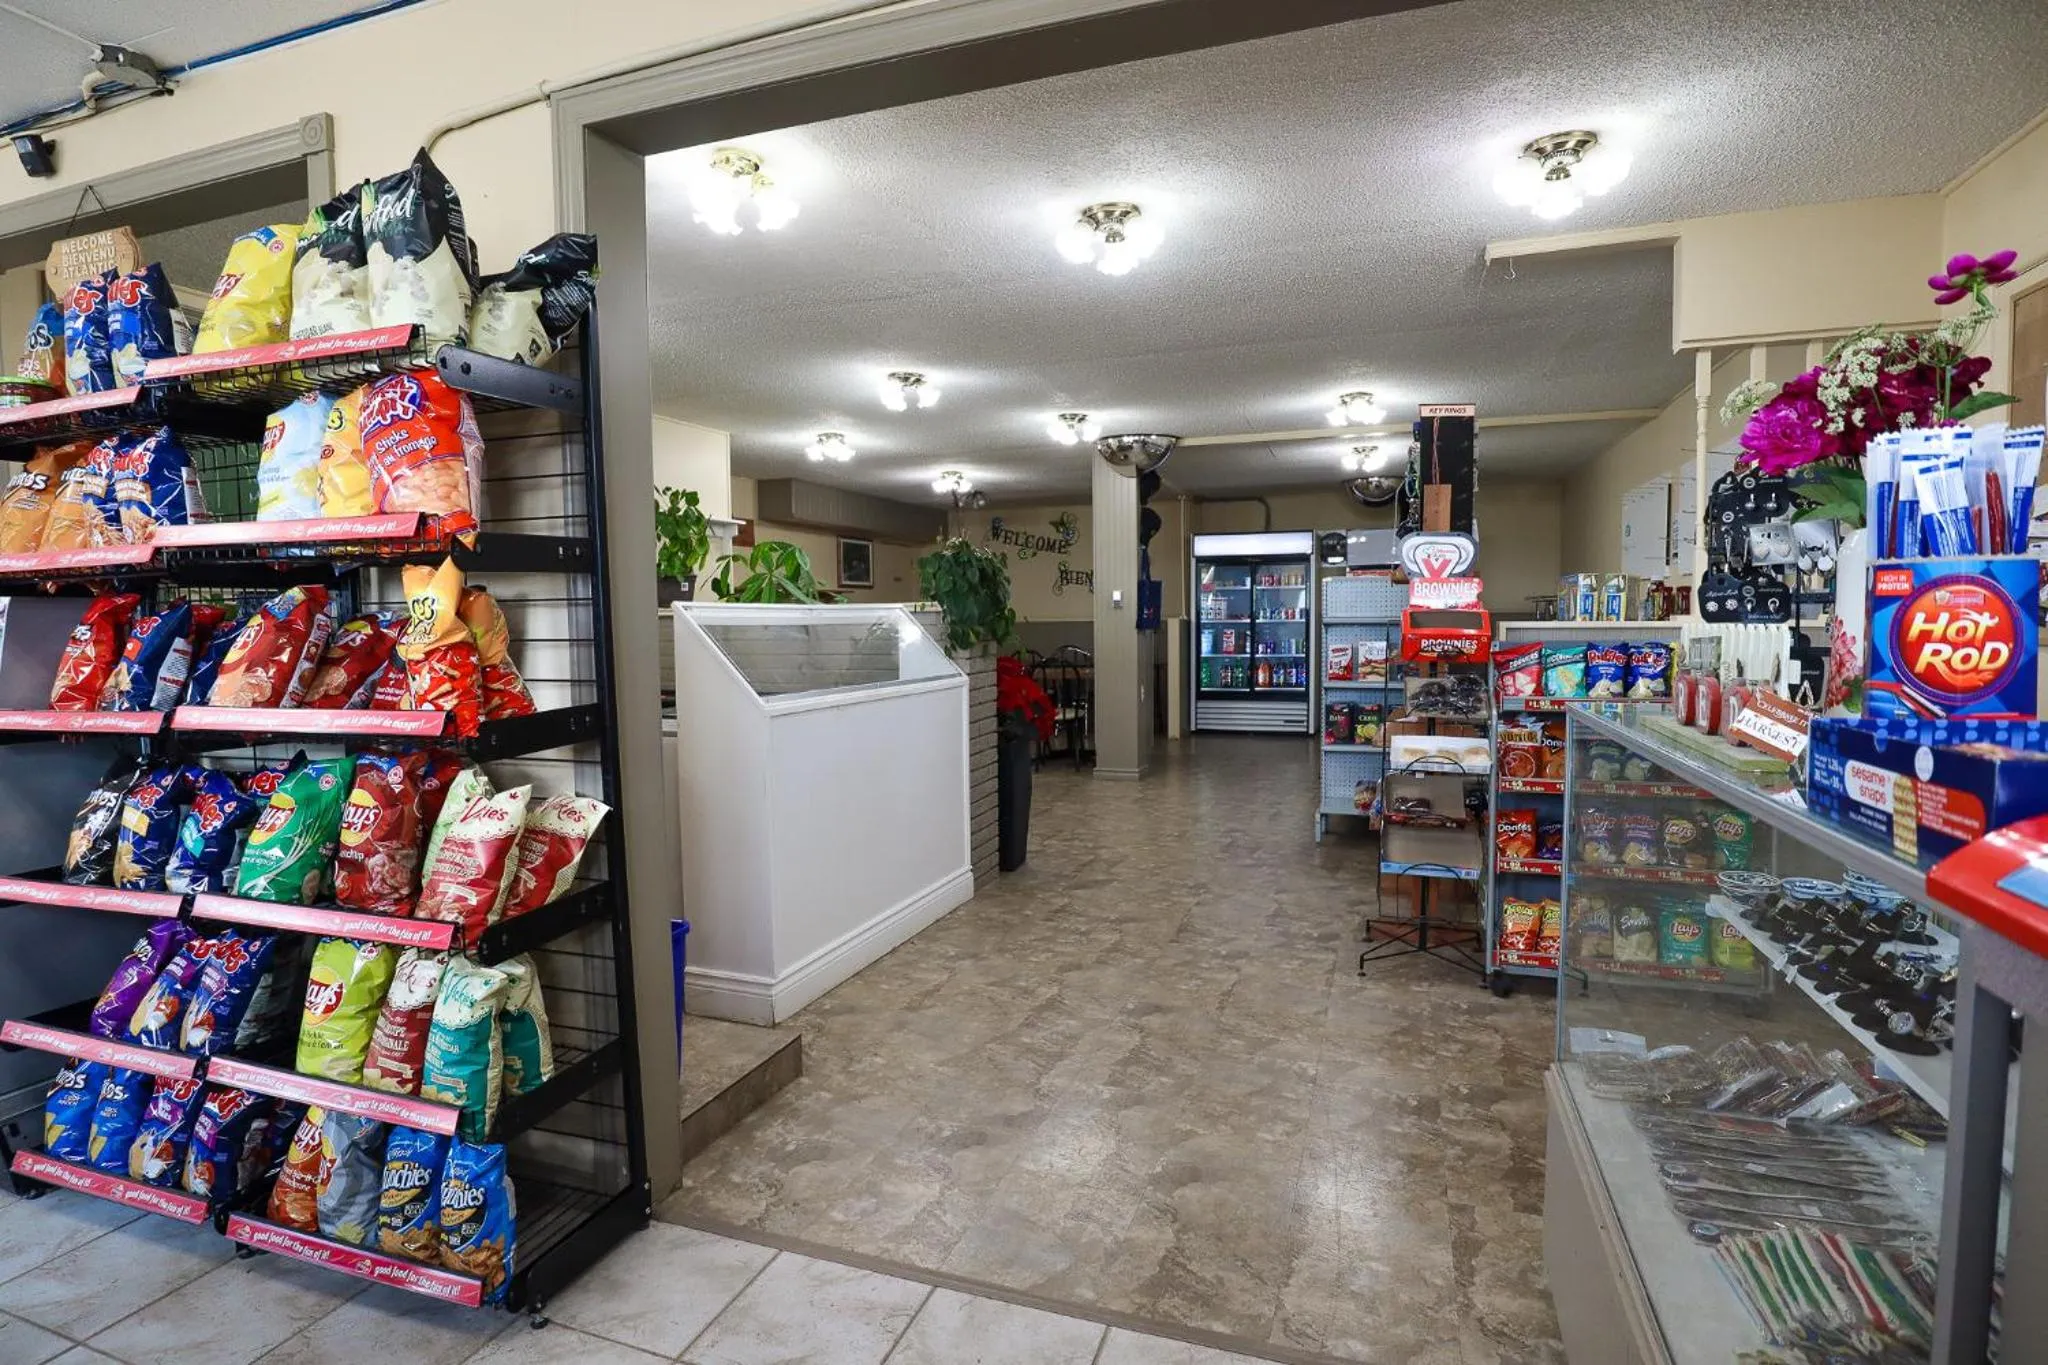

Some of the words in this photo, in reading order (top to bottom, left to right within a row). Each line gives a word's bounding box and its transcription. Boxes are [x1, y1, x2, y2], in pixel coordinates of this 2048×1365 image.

[62, 232, 114, 254] WELCOME
[62, 247, 116, 267] BIENVENU
[376, 429, 409, 454] Sticks
[384, 454, 396, 465] au
[991, 527, 1069, 555] WELCOME
[1414, 580, 1479, 597] BROWNIES
[1877, 582, 1910, 590] PROTEIN
[1421, 638, 1478, 652] BROWNIES
[1736, 714, 1799, 749] HARVEST
[1851, 765, 1886, 787] sesame
[1859, 785, 1887, 807] snaps
[361, 920, 378, 931] food
[376, 922, 390, 934] for
[389, 926, 401, 937] the
[413, 930, 423, 942] of
[253, 1232, 269, 1242] good
[268, 1232, 284, 1244] food
[283, 1236, 293, 1247] for
[293, 1241, 303, 1252] the
[313, 1250, 322, 1261] of
[321, 1250, 330, 1260] it!
[374, 1265, 392, 1277] good
[390, 1266, 409, 1278] food
[407, 1271, 420, 1283] for
[418, 1276, 431, 1287] the
[430, 1281, 442, 1293] fun
[442, 1284, 452, 1297] of
[451, 1285, 461, 1297] it!
